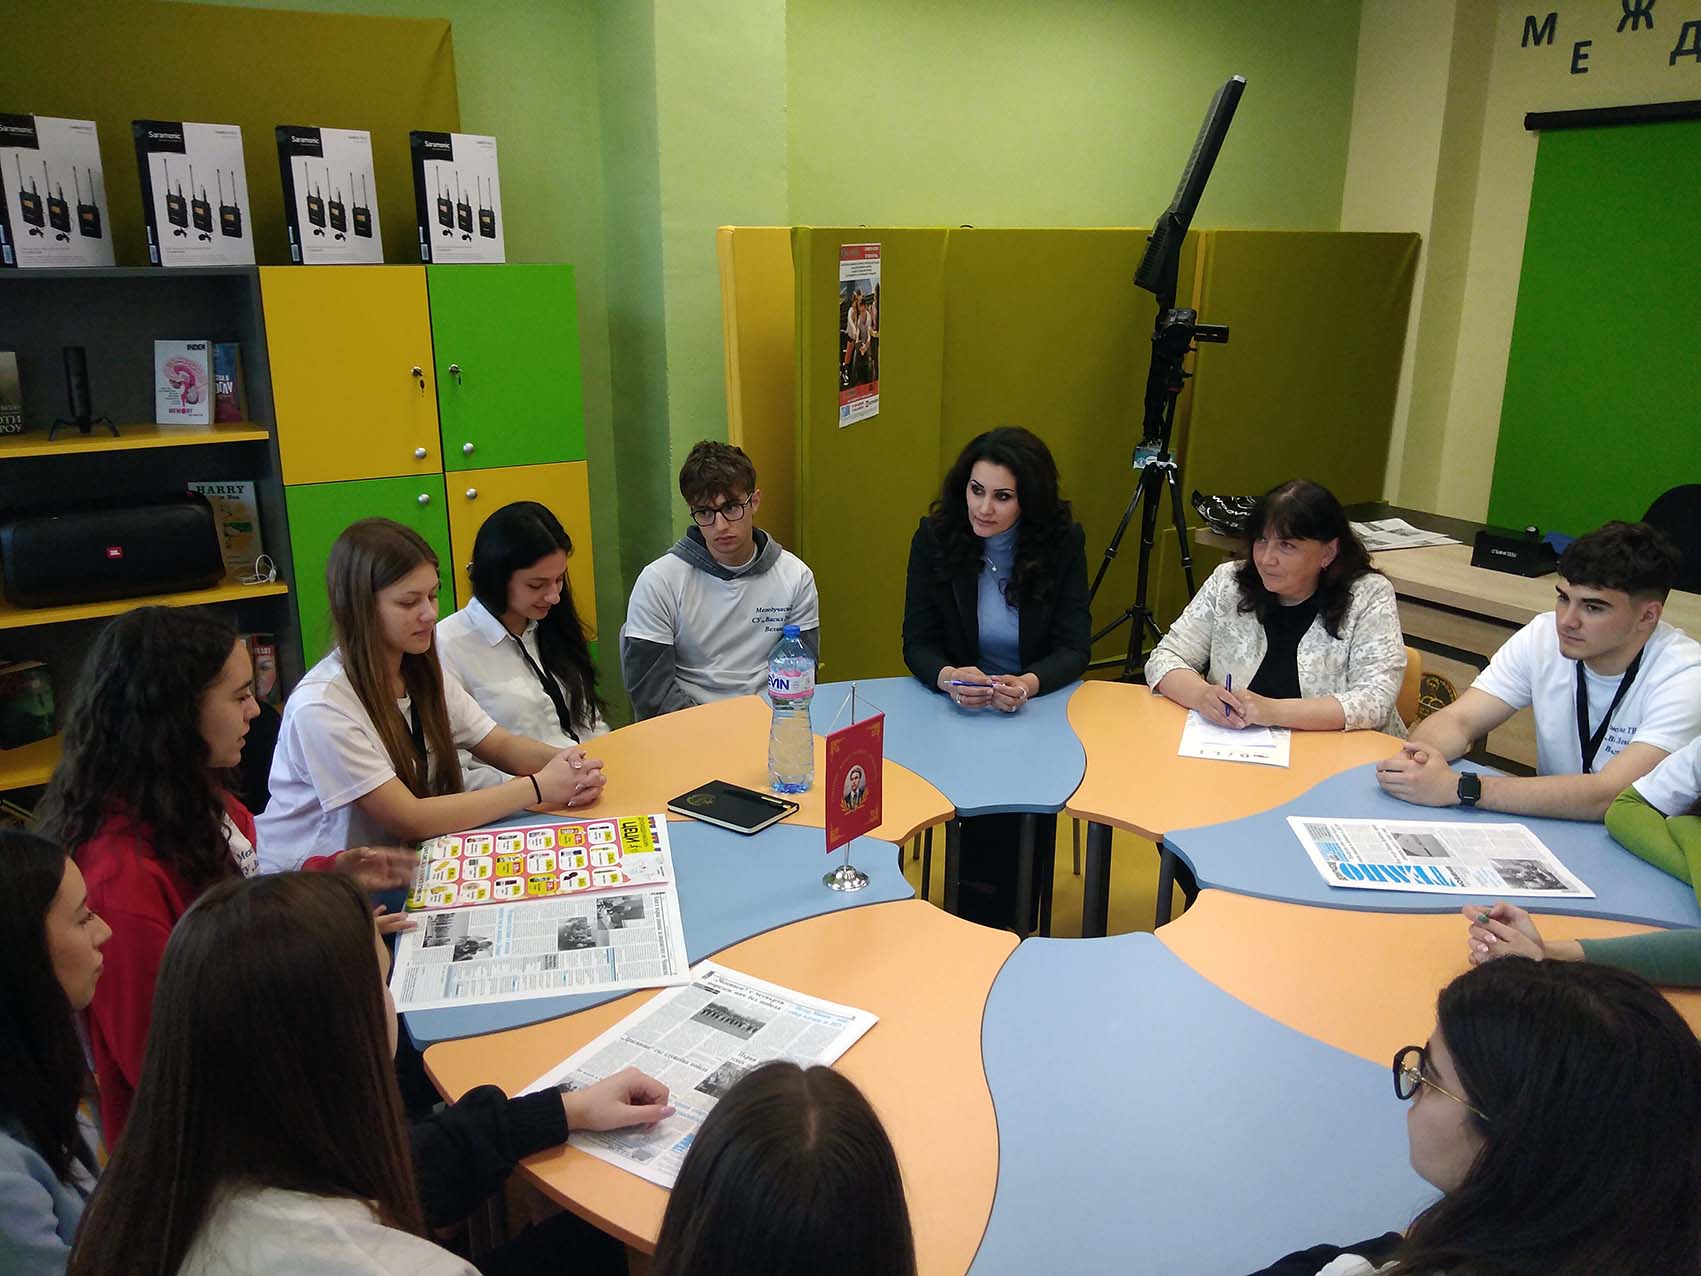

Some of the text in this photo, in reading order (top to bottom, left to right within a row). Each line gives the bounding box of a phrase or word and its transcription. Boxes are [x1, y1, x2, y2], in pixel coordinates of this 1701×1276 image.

[148, 130, 182, 140] Saramonic
[291, 135, 320, 145] Saramonic
[424, 140, 451, 149] Saramonic
[187, 343, 206, 351] INDEX
[196, 485, 245, 494] HARRY
[1339, 863, 1457, 887] ТЕМПО
